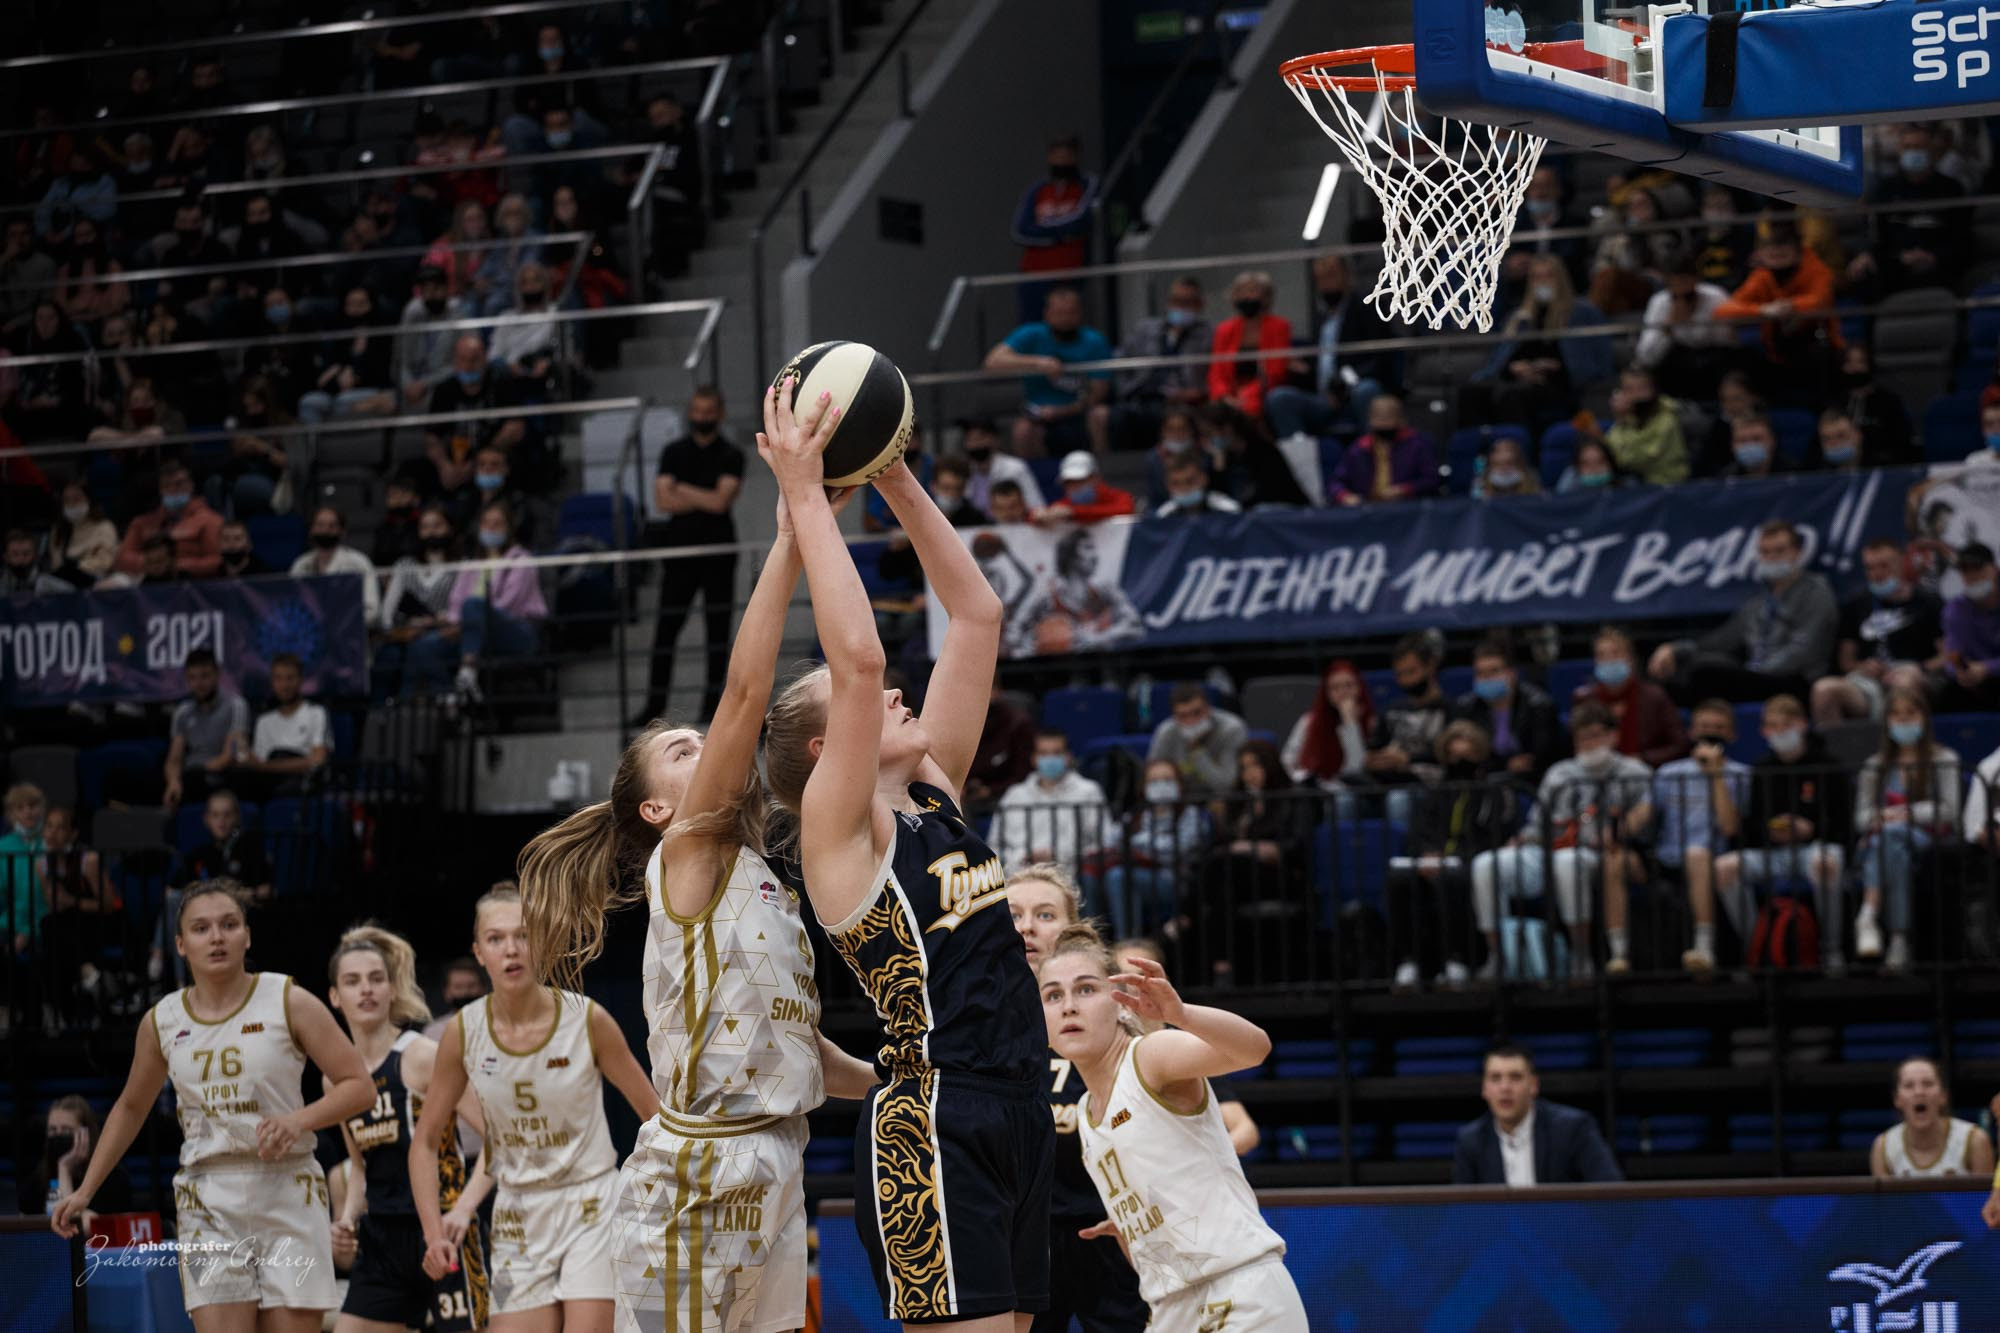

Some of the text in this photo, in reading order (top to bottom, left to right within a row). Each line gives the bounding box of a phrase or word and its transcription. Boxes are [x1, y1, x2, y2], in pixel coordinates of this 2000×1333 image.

[147, 611, 224, 669] 2021
[193, 1047, 243, 1081] 76
[514, 1081, 538, 1112] 5
[1097, 1148, 1128, 1199] 17
[712, 1206, 762, 1232] LAND
[438, 1290, 469, 1319] 31
